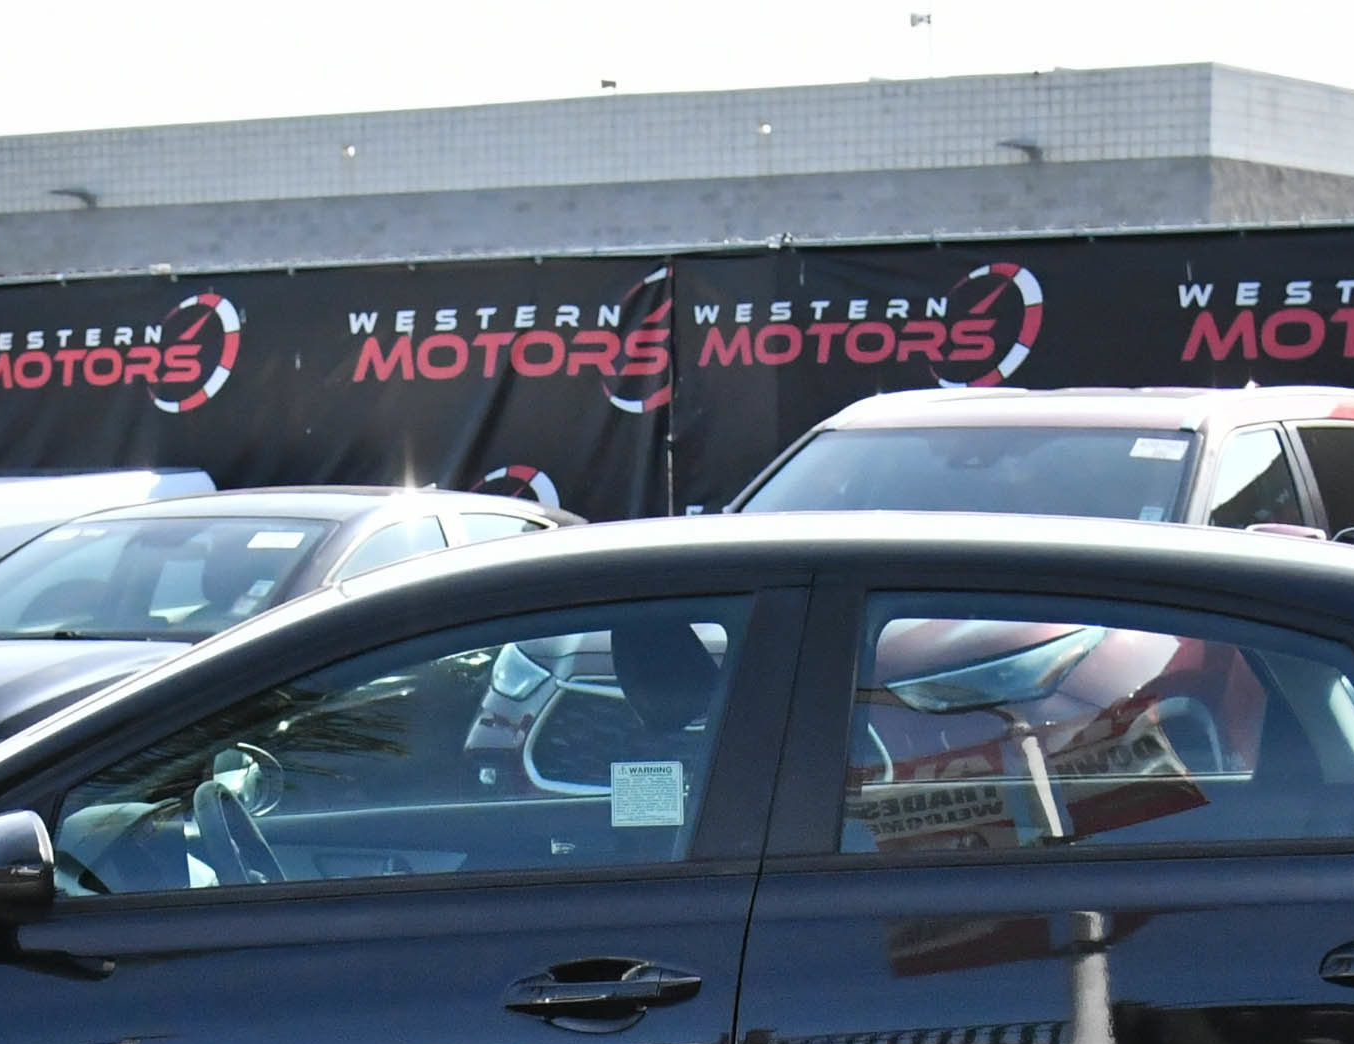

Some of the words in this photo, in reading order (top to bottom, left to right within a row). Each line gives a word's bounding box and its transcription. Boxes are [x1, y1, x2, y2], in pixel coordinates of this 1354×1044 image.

[348, 303, 622, 335] WESTERN
[693, 296, 948, 326] WESTERN
[353, 328, 671, 383] MOTORS
[698, 318, 997, 367] MOTORS
[630, 766, 673, 774] WARNING
